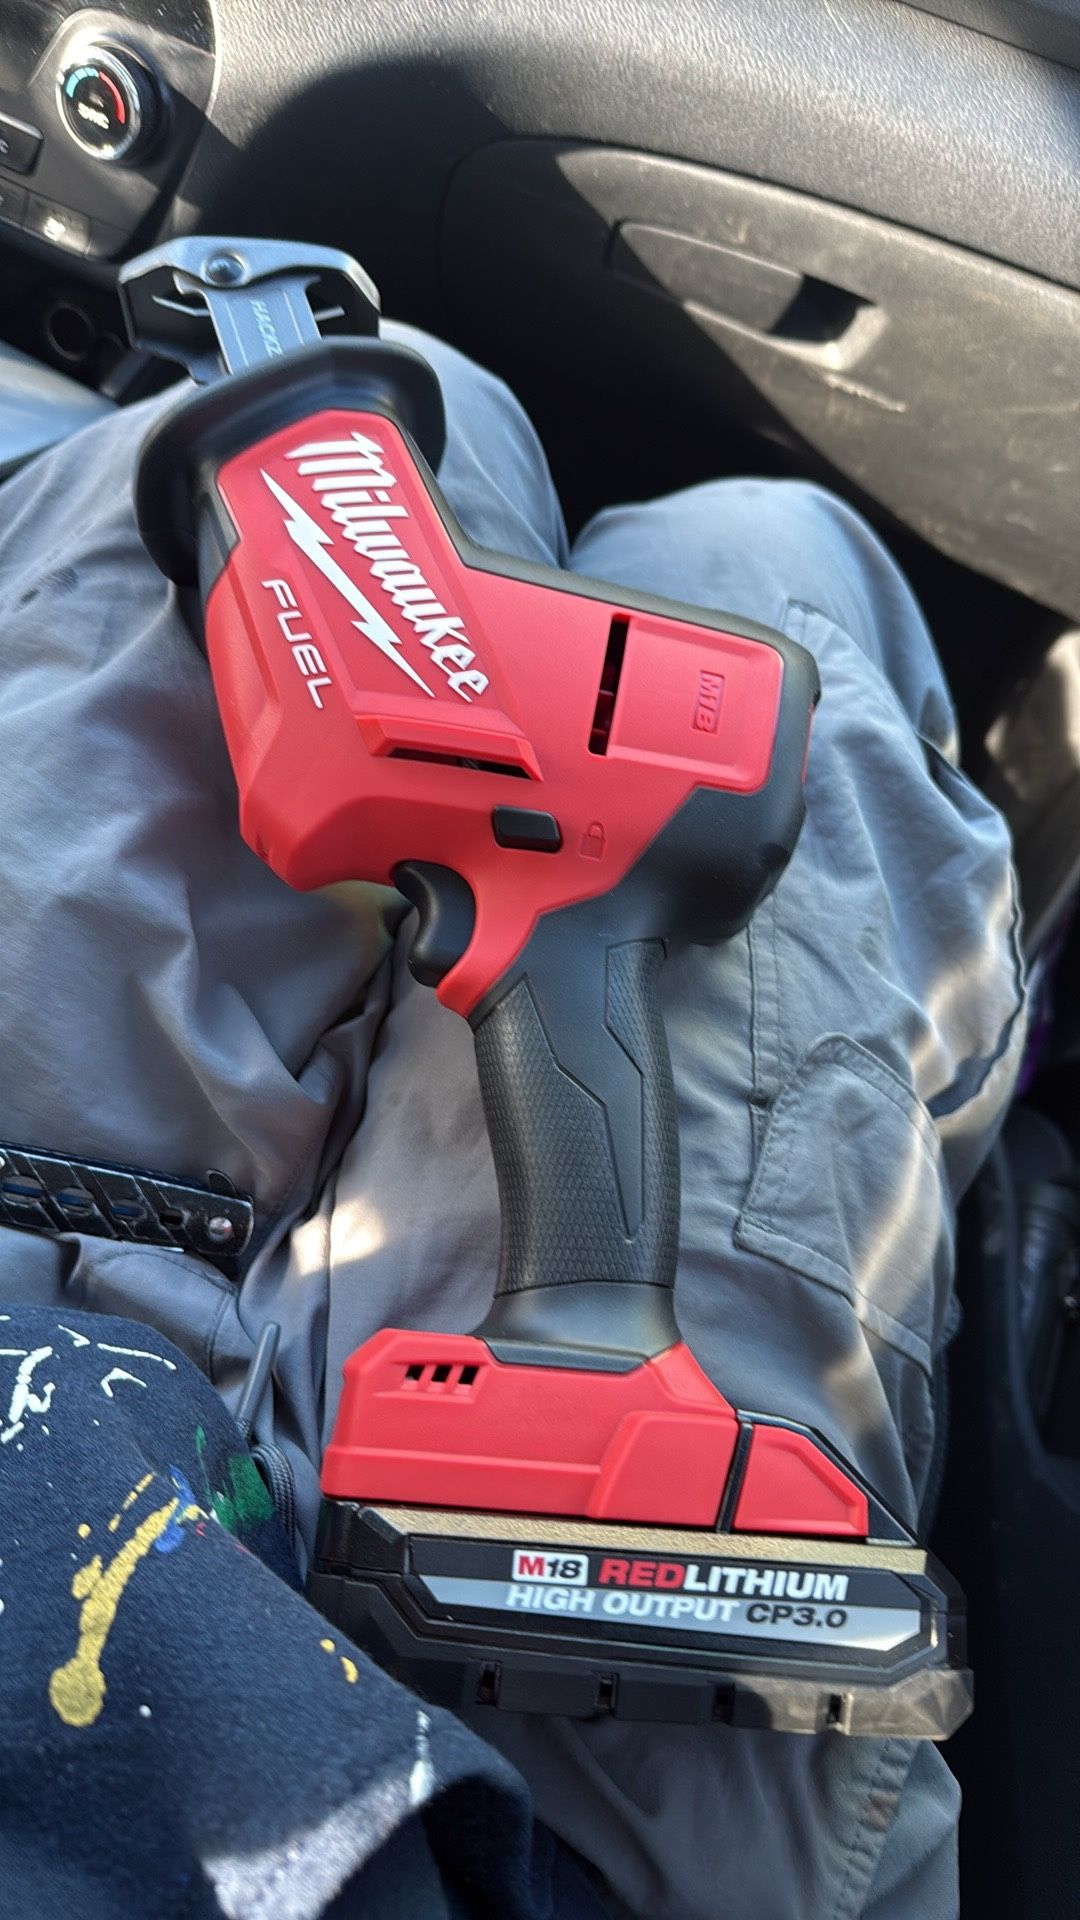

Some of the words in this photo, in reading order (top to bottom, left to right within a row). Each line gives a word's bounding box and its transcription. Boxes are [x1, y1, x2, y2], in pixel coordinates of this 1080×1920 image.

[283, 431, 489, 703] Milwaukee
[261, 579, 333, 709] FUEL
[695, 671, 724, 733] M18
[506, 1584, 596, 1613] HIGH
[602, 1591, 740, 1623] OUTPUT
[745, 1603, 848, 1629] CP3.0
[517, 1555, 582, 1580] M18
[599, 1558, 849, 1601] REDLITHIUM
